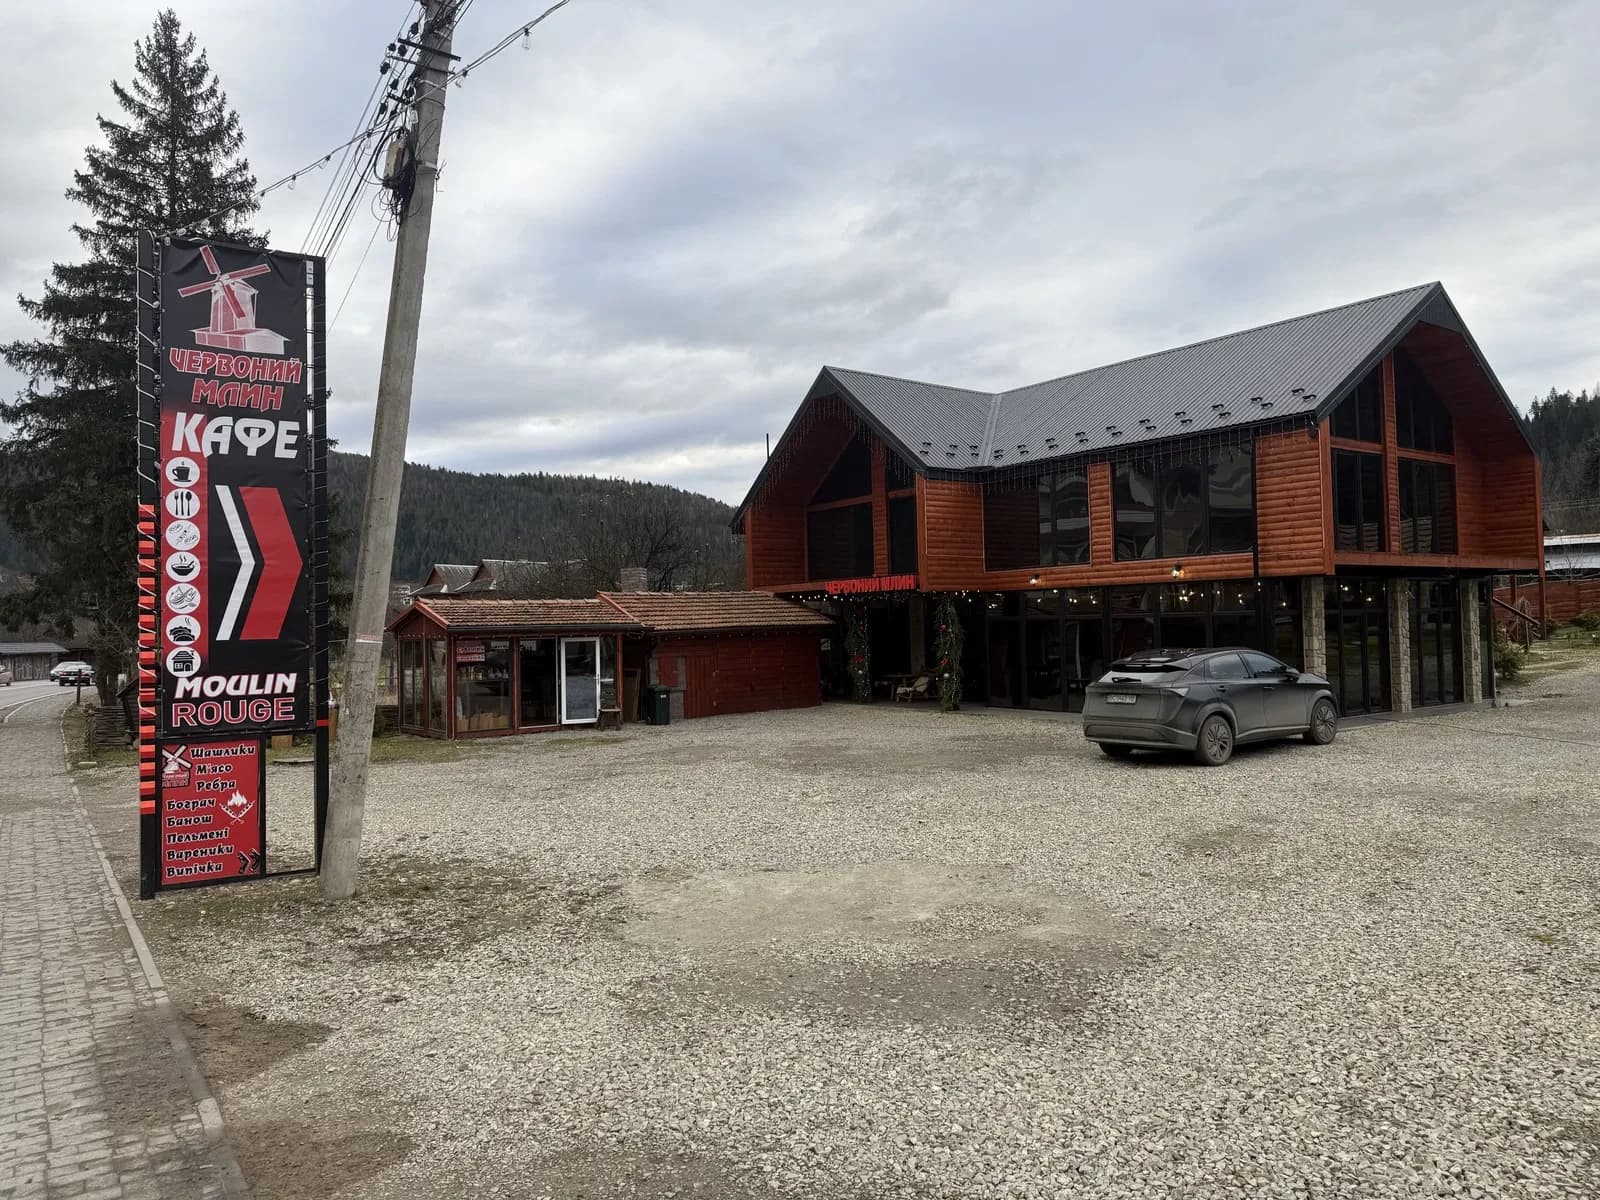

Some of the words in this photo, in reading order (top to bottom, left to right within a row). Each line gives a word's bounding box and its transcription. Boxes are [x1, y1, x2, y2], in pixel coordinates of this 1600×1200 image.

[169, 347, 302, 384] ЧЕРВОНИЙ
[192, 378, 284, 412] МЛИН
[171, 412, 300, 459] КАФЕ
[174, 673, 297, 698] MOULIN
[171, 697, 296, 727] ROUGE
[190, 744, 255, 759] Шашлики
[196, 777, 236, 792] Ребра
[166, 798, 216, 811] Бограч
[166, 815, 212, 828] Банош
[166, 827, 229, 844] Пельмені
[166, 843, 234, 861] Вареники
[166, 861, 223, 878] Випічка
